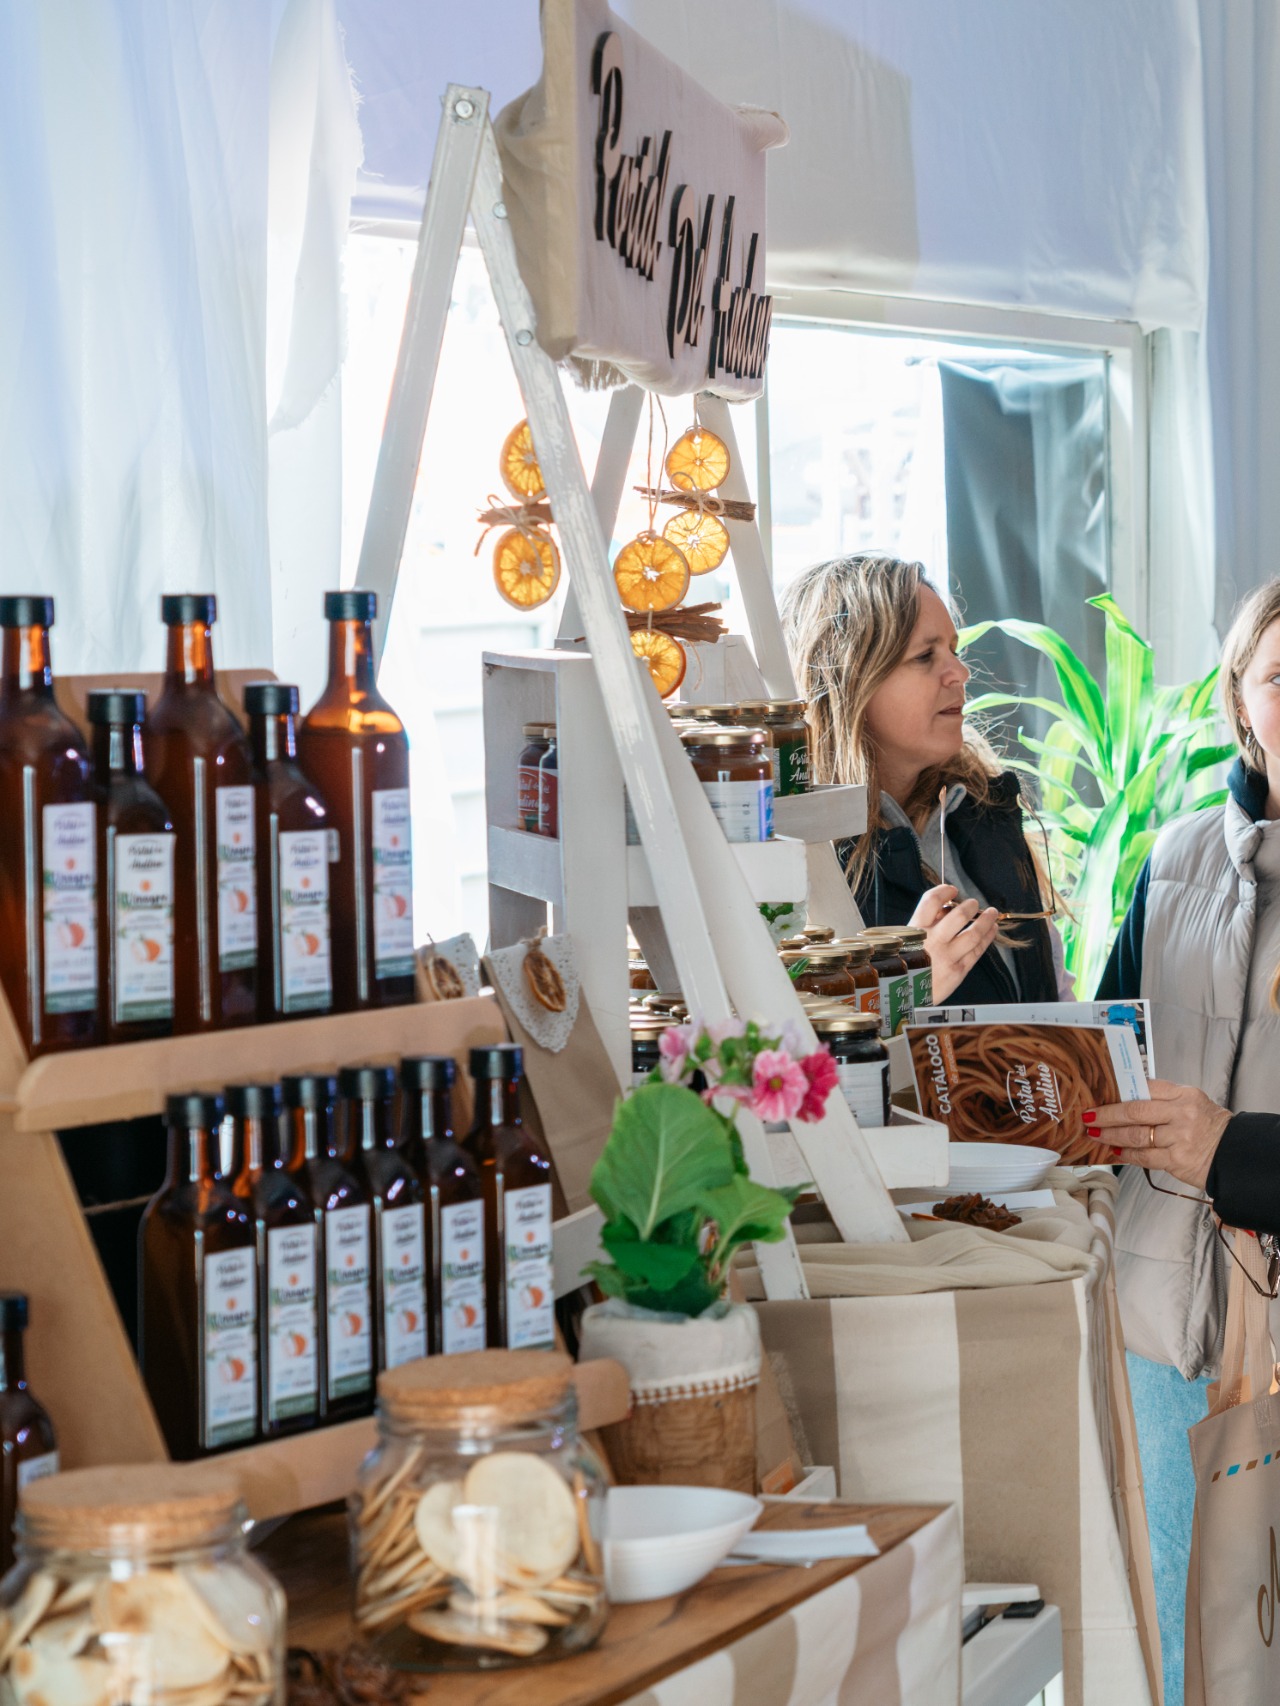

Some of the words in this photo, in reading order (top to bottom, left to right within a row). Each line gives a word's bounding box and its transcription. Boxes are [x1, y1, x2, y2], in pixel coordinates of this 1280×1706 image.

[591, 31, 672, 281] Portal
[709, 194, 773, 379] Andino
[926, 1034, 952, 1114] CATÁLOGO
[1014, 1078, 1038, 1124] Portal
[1036, 1061, 1060, 1123] Andino
